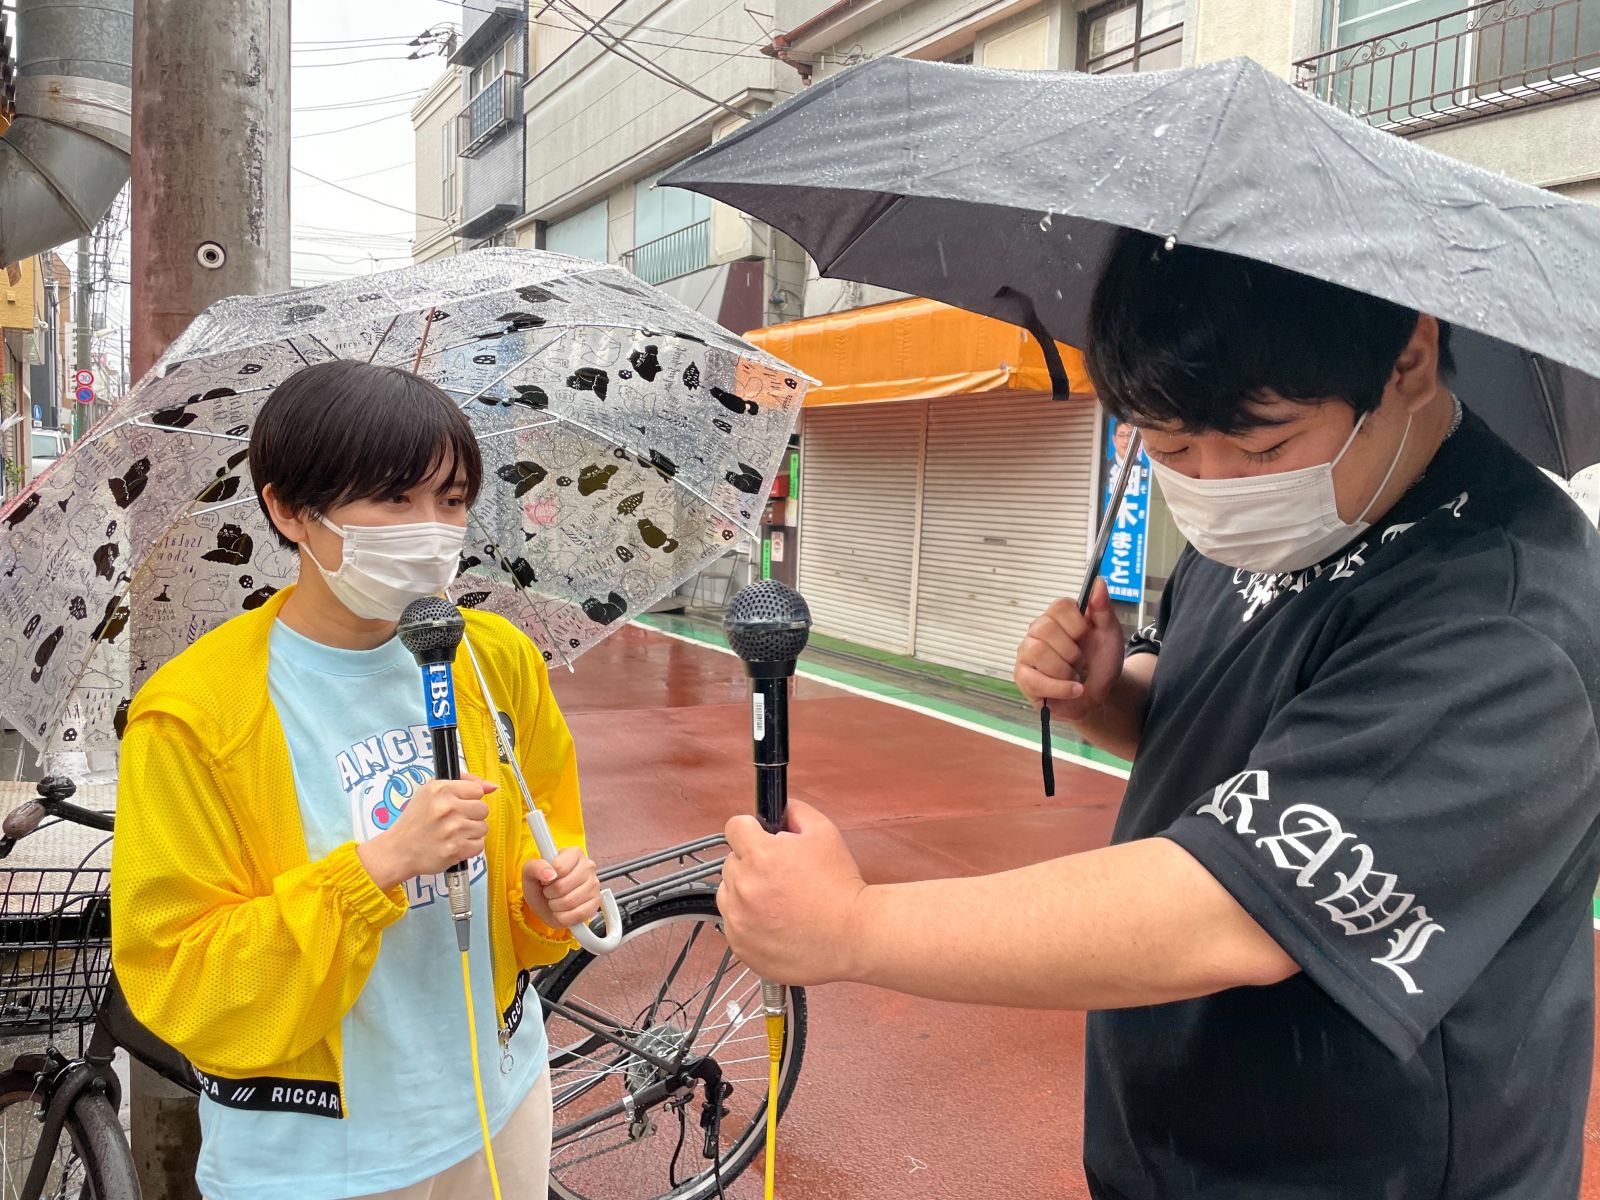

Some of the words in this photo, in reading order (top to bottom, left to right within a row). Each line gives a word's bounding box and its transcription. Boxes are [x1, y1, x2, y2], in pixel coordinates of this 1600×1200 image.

[80, 374, 91, 382] 30
[429, 664, 450, 719] TBS
[335, 724, 465, 793] ANGE
[271, 1086, 340, 1112] RICCAR
